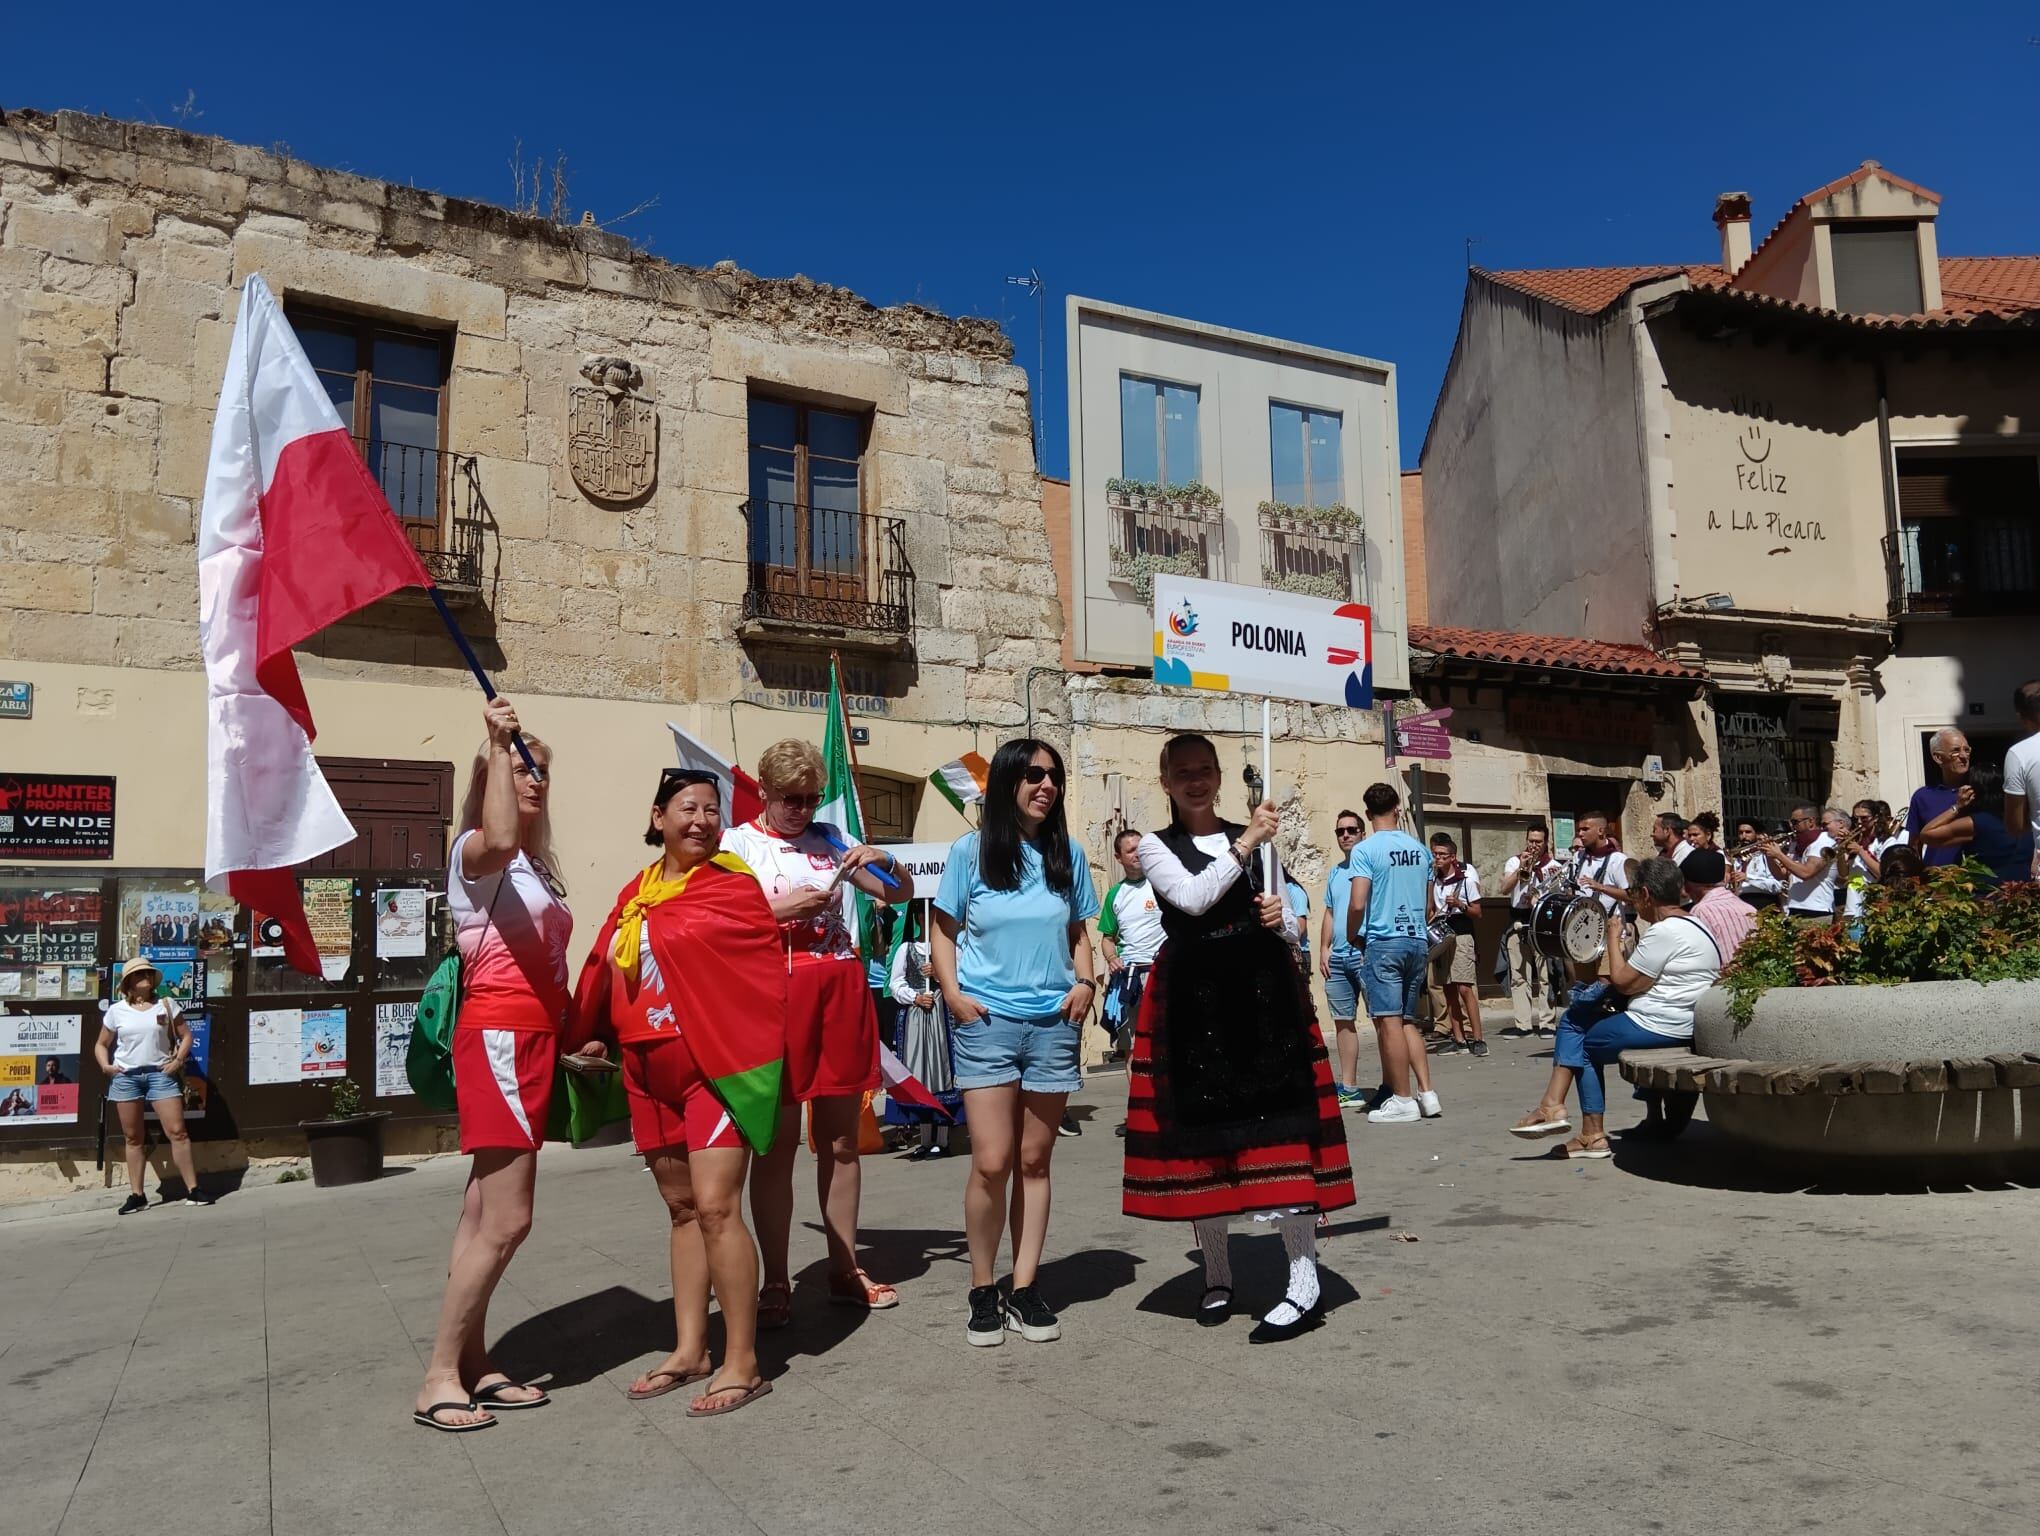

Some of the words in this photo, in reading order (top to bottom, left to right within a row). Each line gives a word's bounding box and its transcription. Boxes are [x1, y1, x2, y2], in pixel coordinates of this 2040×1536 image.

[1736, 464, 1787, 494] Feliz
[1708, 510, 1721, 530] a
[1732, 509, 1758, 530] La
[1765, 512, 1826, 540] Picara
[1232, 621, 1307, 657] POLONIA
[0, 700, 26, 710] ARIA
[26, 784, 111, 800] HUNTER
[25, 800, 112, 812] PROPERTIES
[24, 816, 111, 828] VENDE
[1390, 850, 1421, 866] STAFF
[24, 912, 102, 923] PROPERTIE
[4, 932, 95, 944] VENDE
[81, 945, 94, 953] 90
[379, 1004, 389, 1018] EL
[10, 1065, 31, 1076] POVEDA
